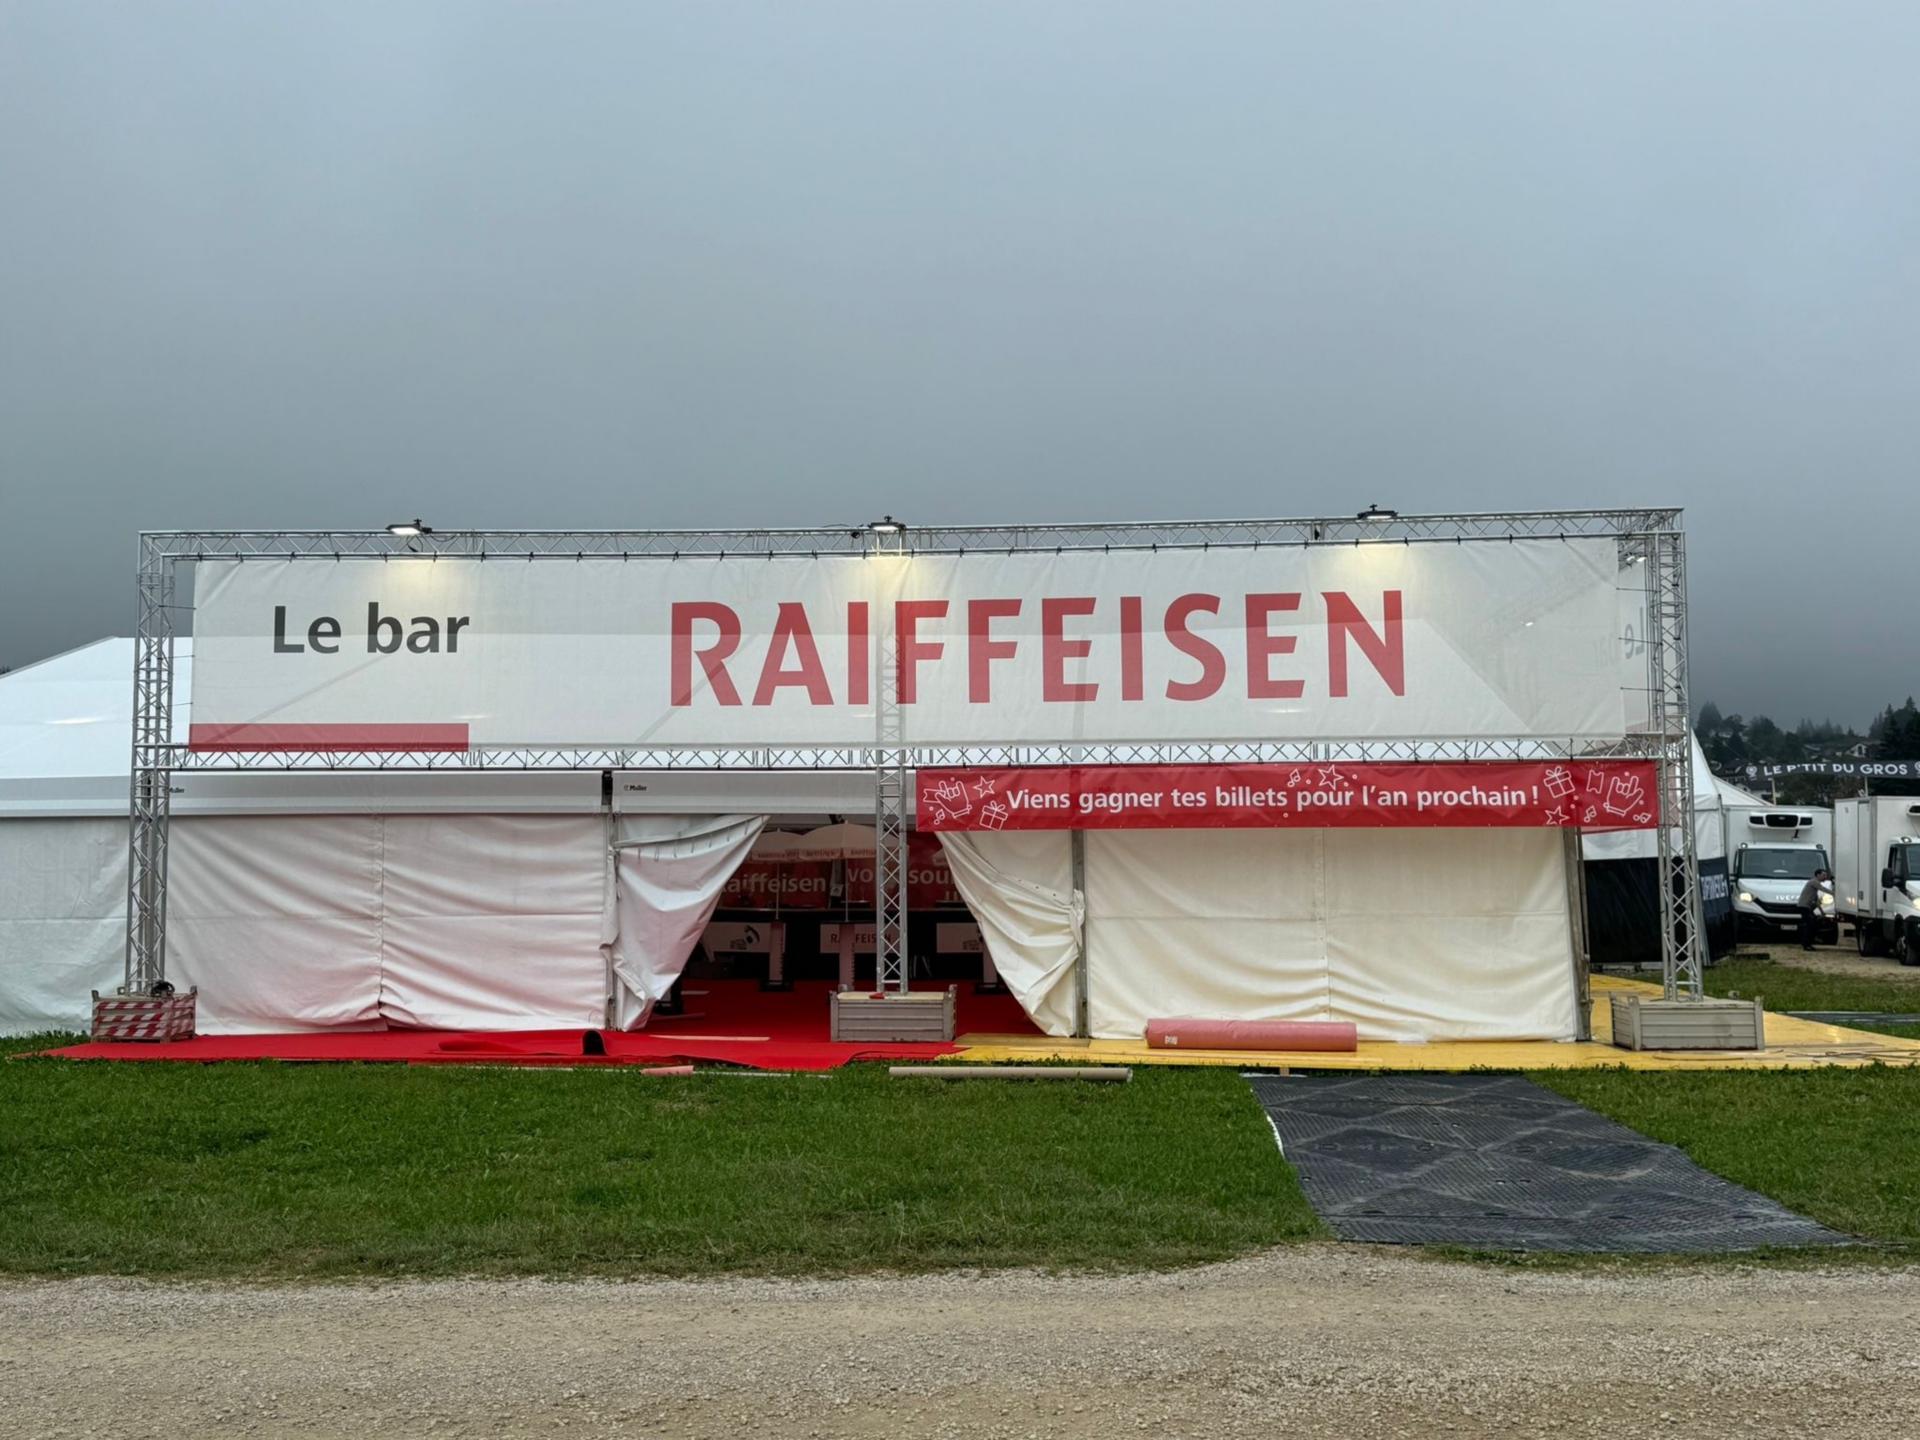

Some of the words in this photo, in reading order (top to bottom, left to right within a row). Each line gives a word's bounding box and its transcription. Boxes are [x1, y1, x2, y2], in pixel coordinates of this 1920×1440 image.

[274, 605, 341, 654] Le
[366, 601, 470, 654] bar
[671, 590, 1404, 706] RAIFFEISEN
[1763, 764, 1783, 776] LE
[1786, 763, 1826, 773] P'TIT
[1832, 763, 1855, 773] DU
[1859, 763, 1908, 775] GROS
[1006, 789, 1071, 810] Viens
[1079, 793, 1164, 815] gagner
[1171, 789, 1206, 807] tes
[1215, 786, 1288, 807] billets
[1296, 788, 1354, 812] pour
[1417, 785, 1527, 811] prochain
[1532, 785, 1539, 805] !
[908, 869, 954, 885] sou
